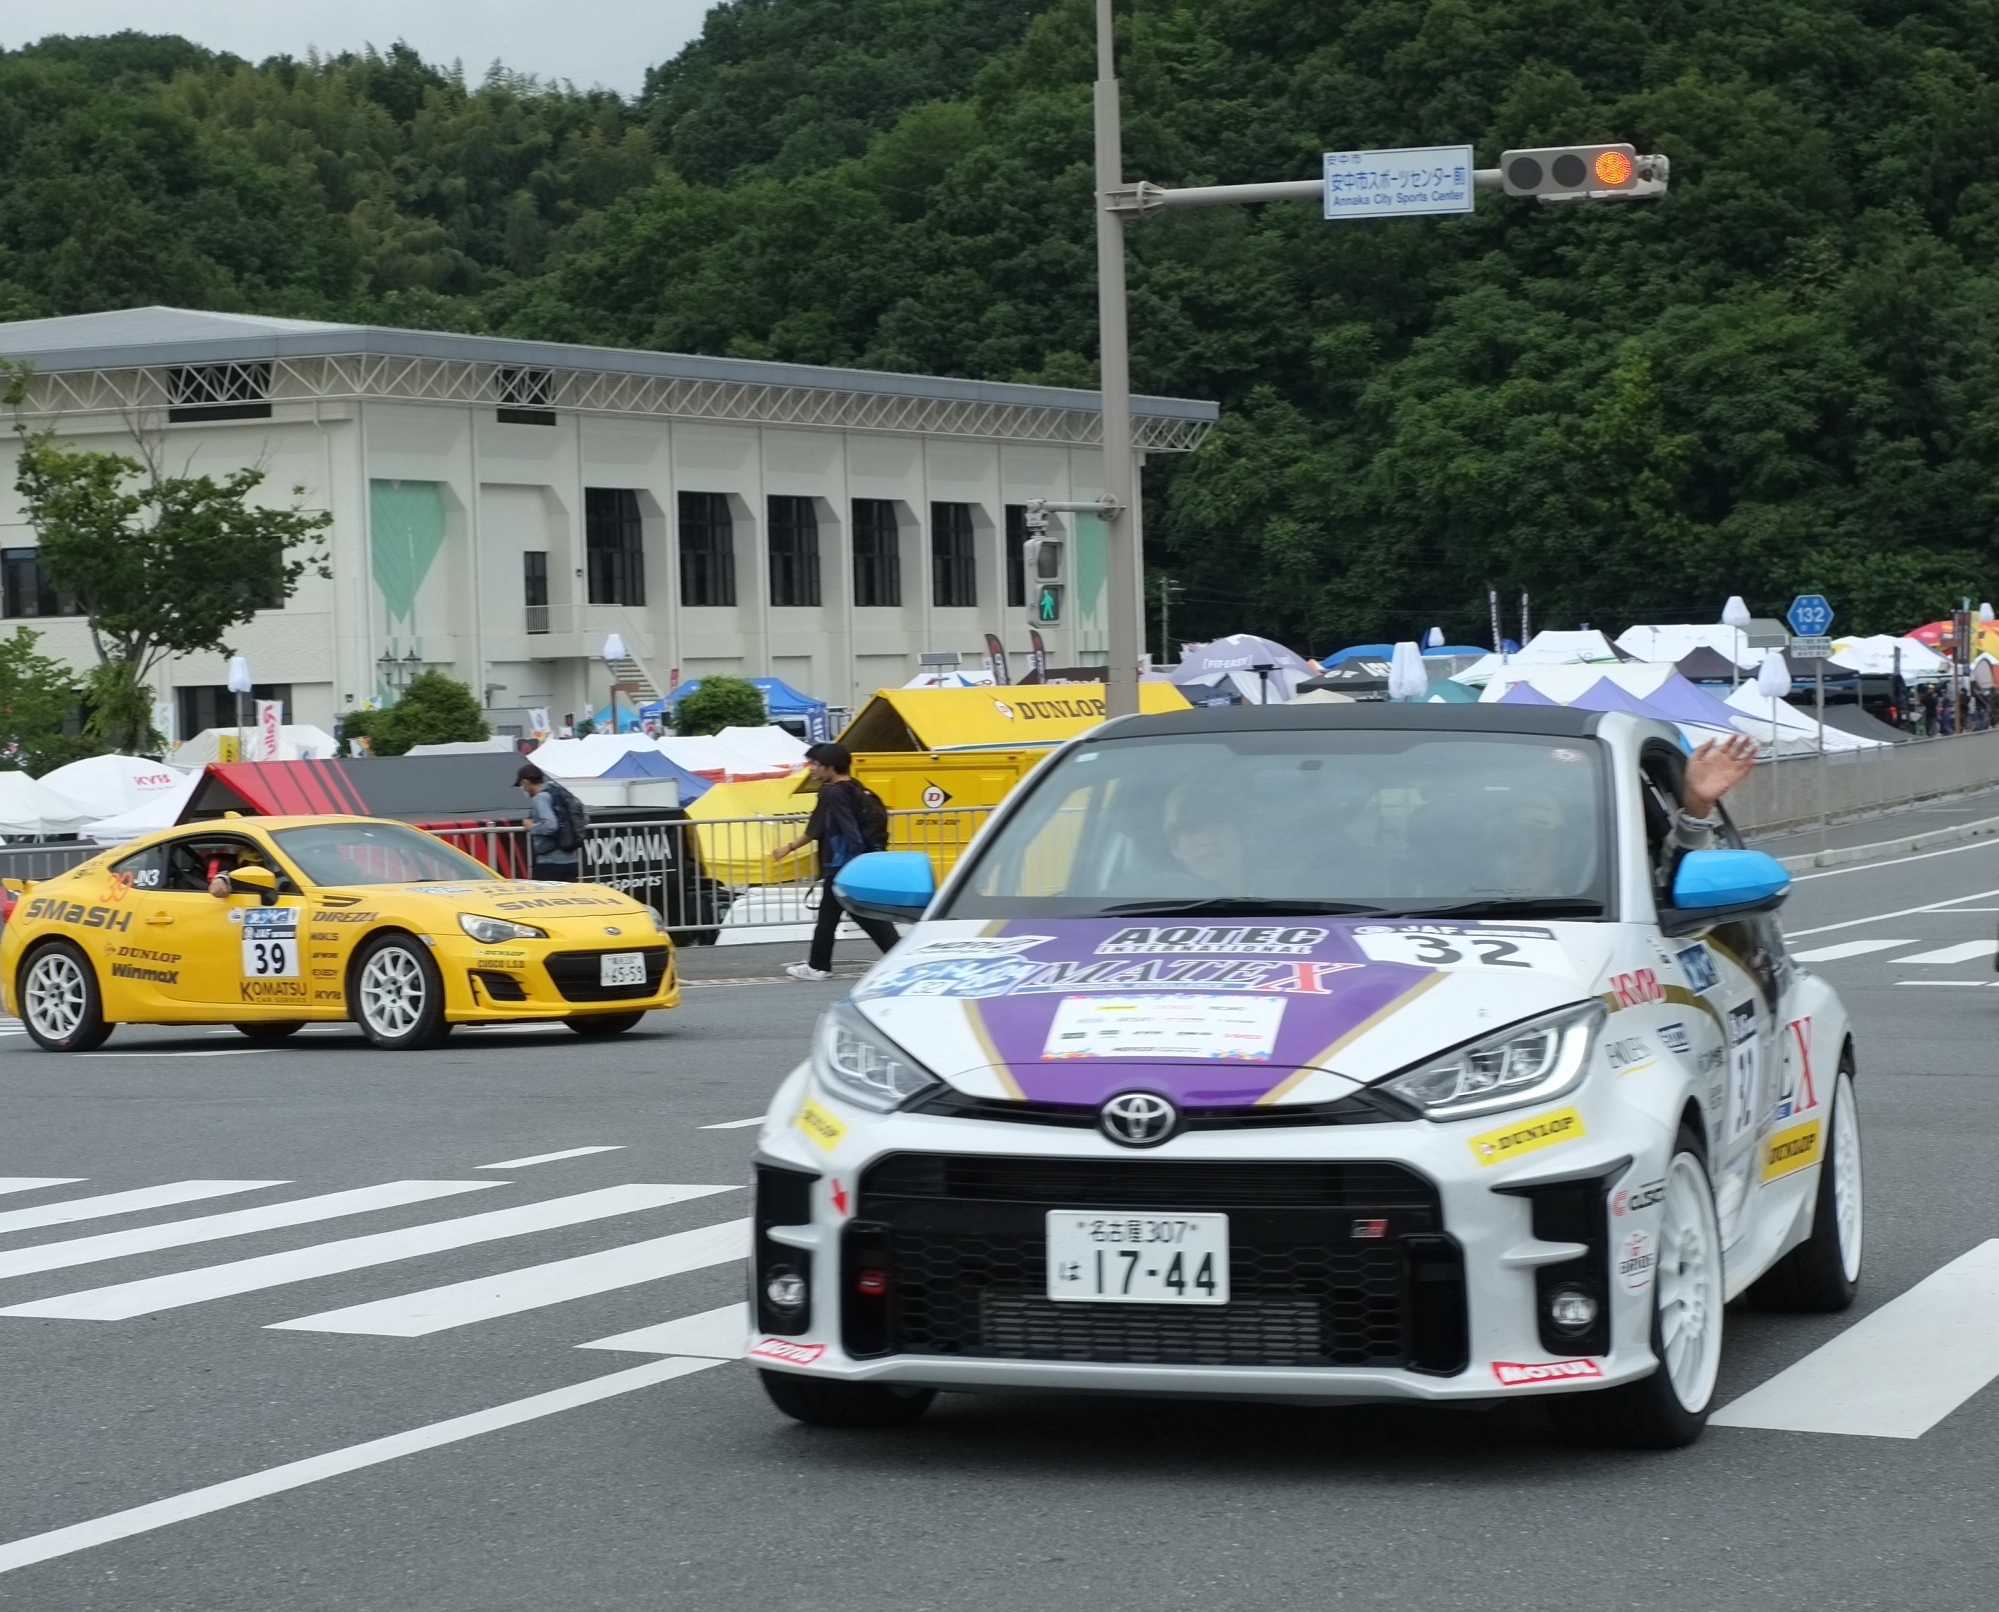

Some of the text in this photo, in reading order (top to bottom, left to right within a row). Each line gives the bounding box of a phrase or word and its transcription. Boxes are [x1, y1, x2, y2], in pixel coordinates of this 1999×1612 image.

[1331, 165, 1465, 192] 安中市スポーツセンター前
[1333, 189, 1464, 206] Annaka City Sports Center
[1795, 606, 1825, 623] 132
[583, 833, 672, 866] YOKOHAMA
[1401, 924, 1460, 936] JAF
[117, 946, 182, 963] DUNLOP
[254, 942, 286, 975] 39
[1098, 944, 1313, 954] INTERNATIONAL
[1404, 935, 1534, 968] 32
[1022, 959, 1364, 994] MATEX
[240, 982, 308, 1002] KOMATSU
[1499, 1116, 1574, 1150] DUNLOP
[1768, 1133, 1816, 1165] DUNLOP
[1057, 1250, 1216, 1297] は 17-44
[1500, 1360, 1599, 1385] MOTUL
